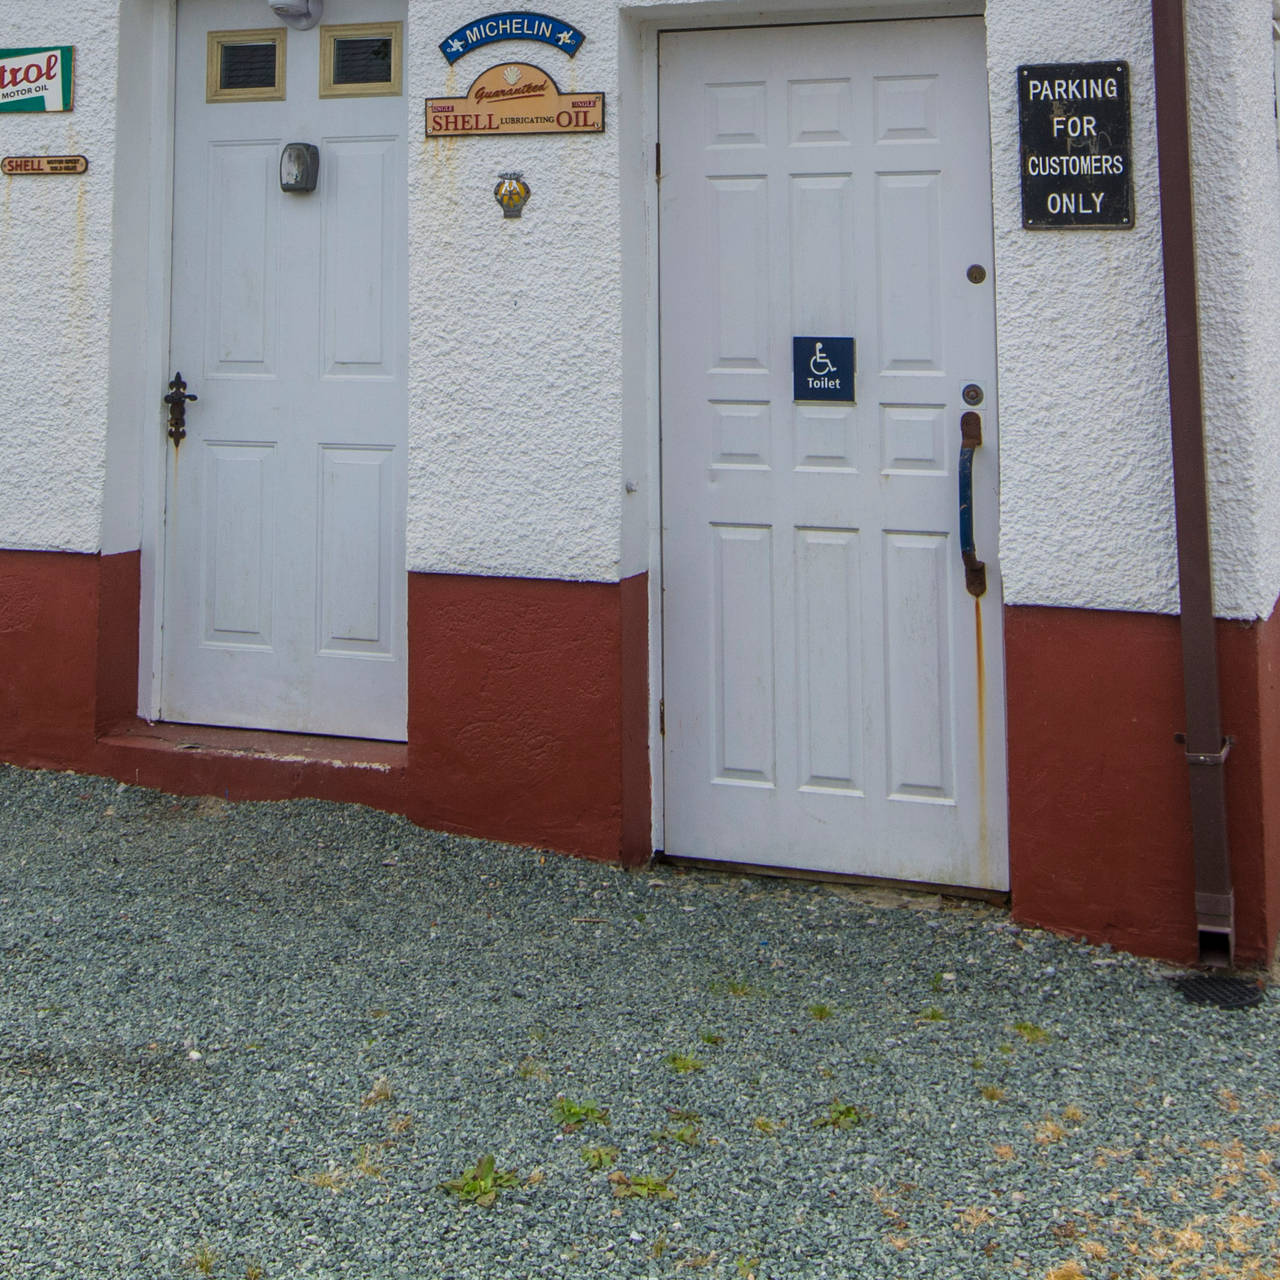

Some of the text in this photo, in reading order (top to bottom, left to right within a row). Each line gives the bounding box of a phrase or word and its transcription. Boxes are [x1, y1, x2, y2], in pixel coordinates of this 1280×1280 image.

[466, 19, 552, 44] MICHELIN
[1, 84, 49, 100] MOTOR OIL
[475, 80, 548, 105] Guaranteed
[1029, 78, 1117, 100] PARKING
[431, 110, 595, 131] SHELL LUBRICATING OIL
[1053, 116, 1097, 137] FOR
[7, 159, 44, 172] SHELL
[1028, 155, 1123, 176] CUSTOMERS
[1047, 192, 1105, 214] ONLY
[807, 377, 841, 389] Toilet
